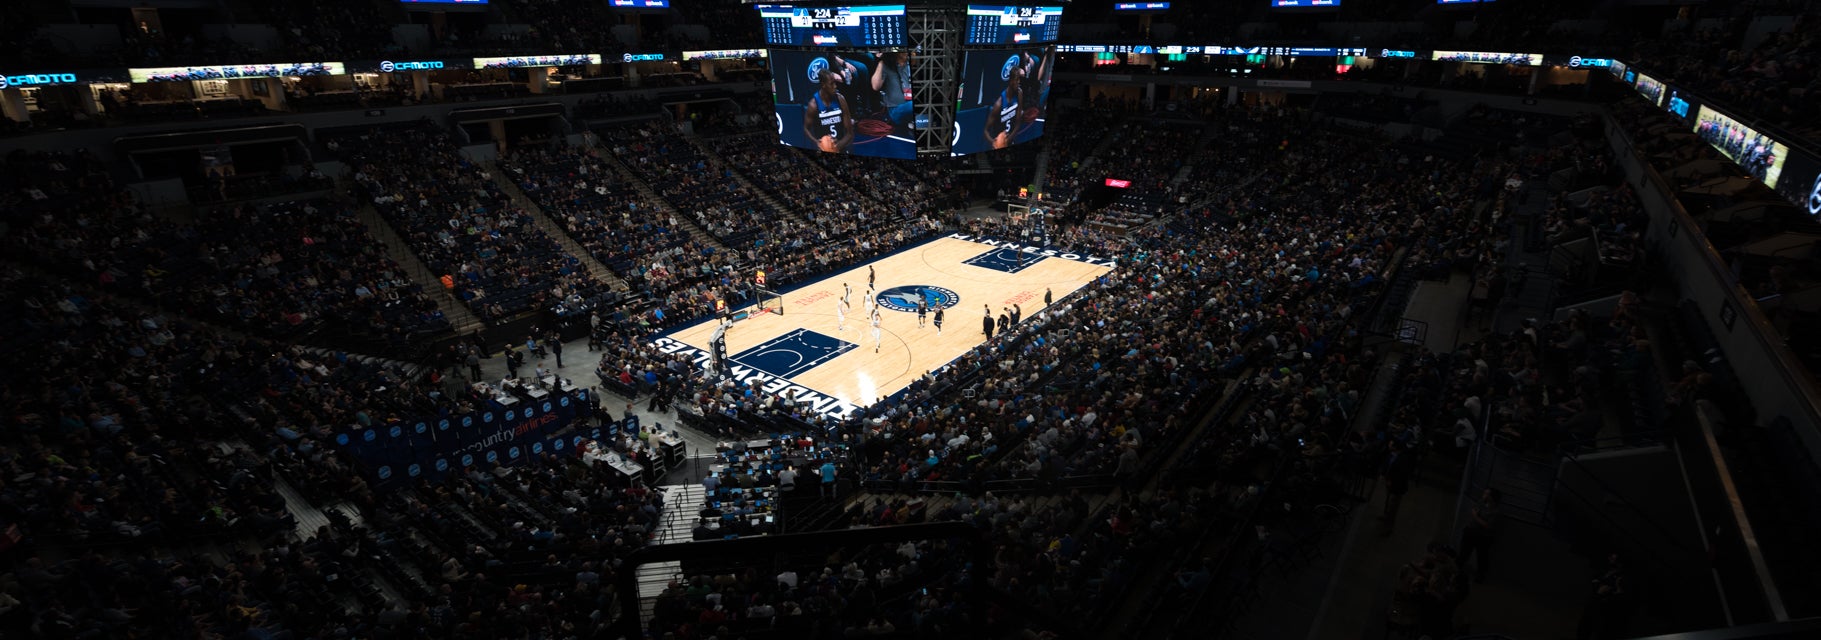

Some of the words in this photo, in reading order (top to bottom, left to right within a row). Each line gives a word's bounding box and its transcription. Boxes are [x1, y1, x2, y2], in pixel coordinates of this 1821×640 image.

[815, 9, 831, 18] 2:24
[837, 16, 846, 25] 22
[395, 61, 444, 70] CFMOTO
[6, 73, 77, 86] CFMOTO
[830, 125, 838, 138] 5
[1005, 120, 1011, 133] 5
